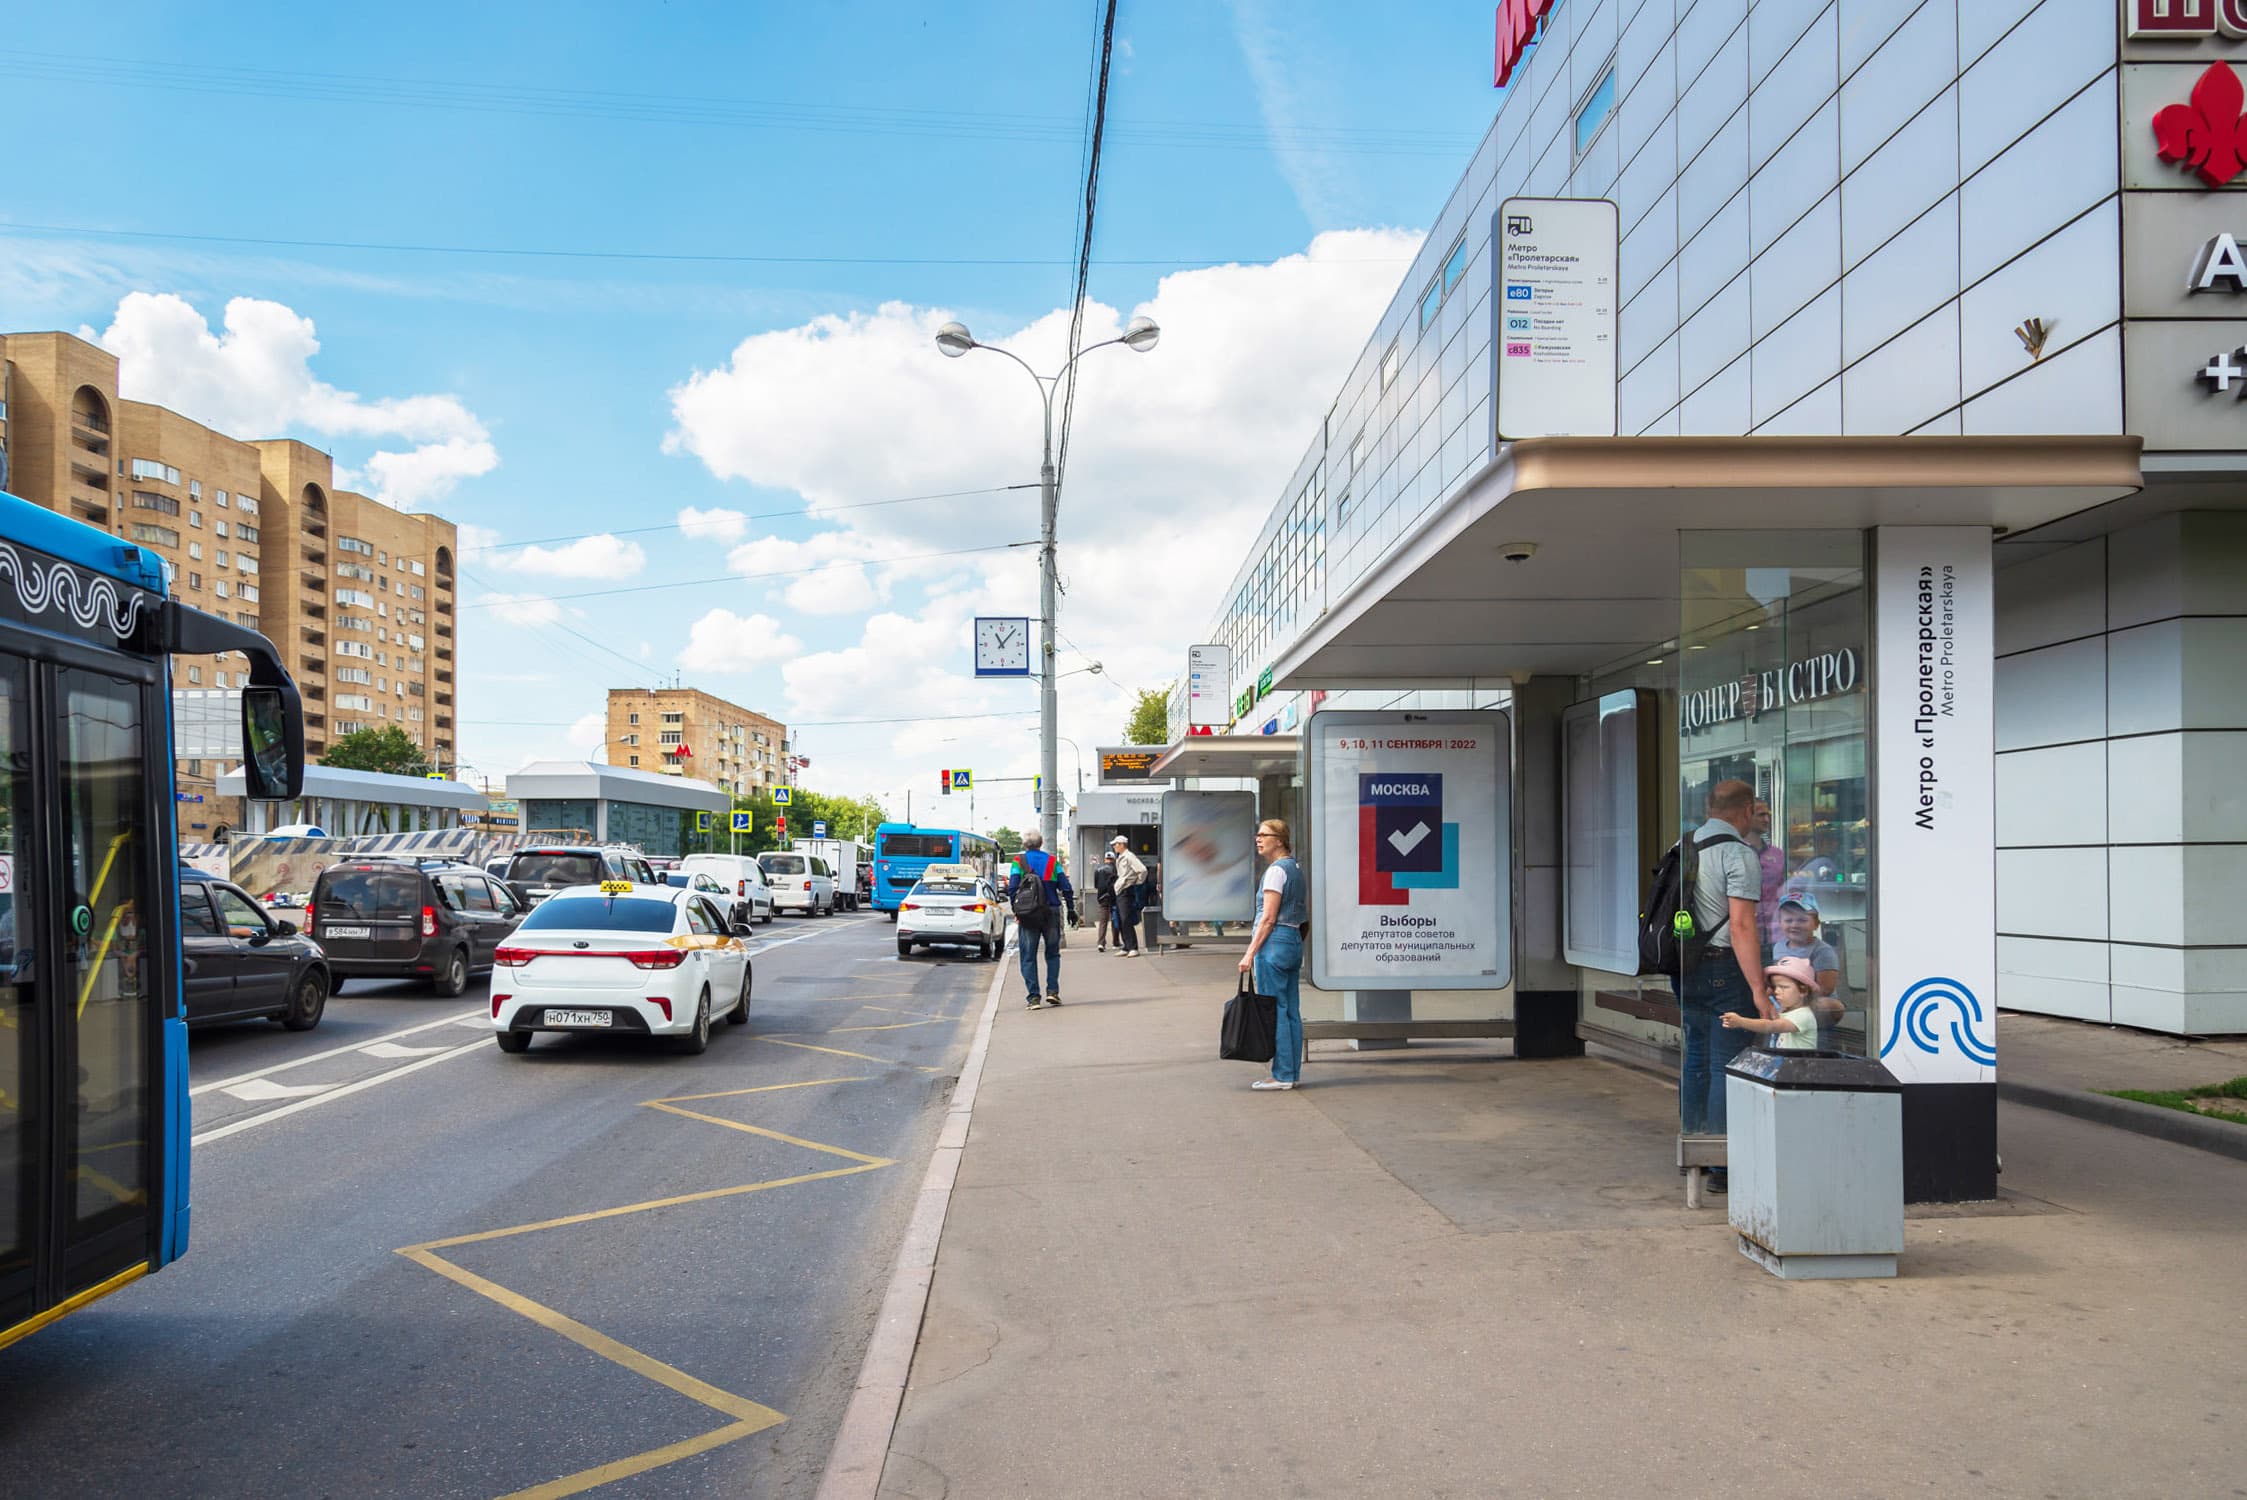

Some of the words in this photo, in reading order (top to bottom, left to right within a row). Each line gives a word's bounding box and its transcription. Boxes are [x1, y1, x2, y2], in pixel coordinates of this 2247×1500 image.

[1508, 243, 1537, 253] Метро
[1508, 253, 1580, 263] «Пролетарская»
[1940, 565, 1956, 665] Proletarskaya
[1914, 566, 1938, 748] «Пролетарская»
[1940, 670, 1954, 717] Metro
[1340, 740, 1350, 751] 9,
[1352, 740, 1369, 751] 10,
[1371, 739, 1383, 749] 11
[1387, 739, 1442, 749] СЕНТЯБРЯ
[1450, 739, 1476, 749] 2022
[1371, 784, 1430, 796] МОСКВА
[1914, 756, 1938, 830] Метро
[1380, 915, 1437, 928] Выборы
[1361, 929, 1412, 940] депутатов
[1415, 930, 1455, 939] советов
[1341, 941, 1392, 952] депутатов
[1394, 941, 1476, 952] муниципальных
[1375, 951, 1441, 962] образований
